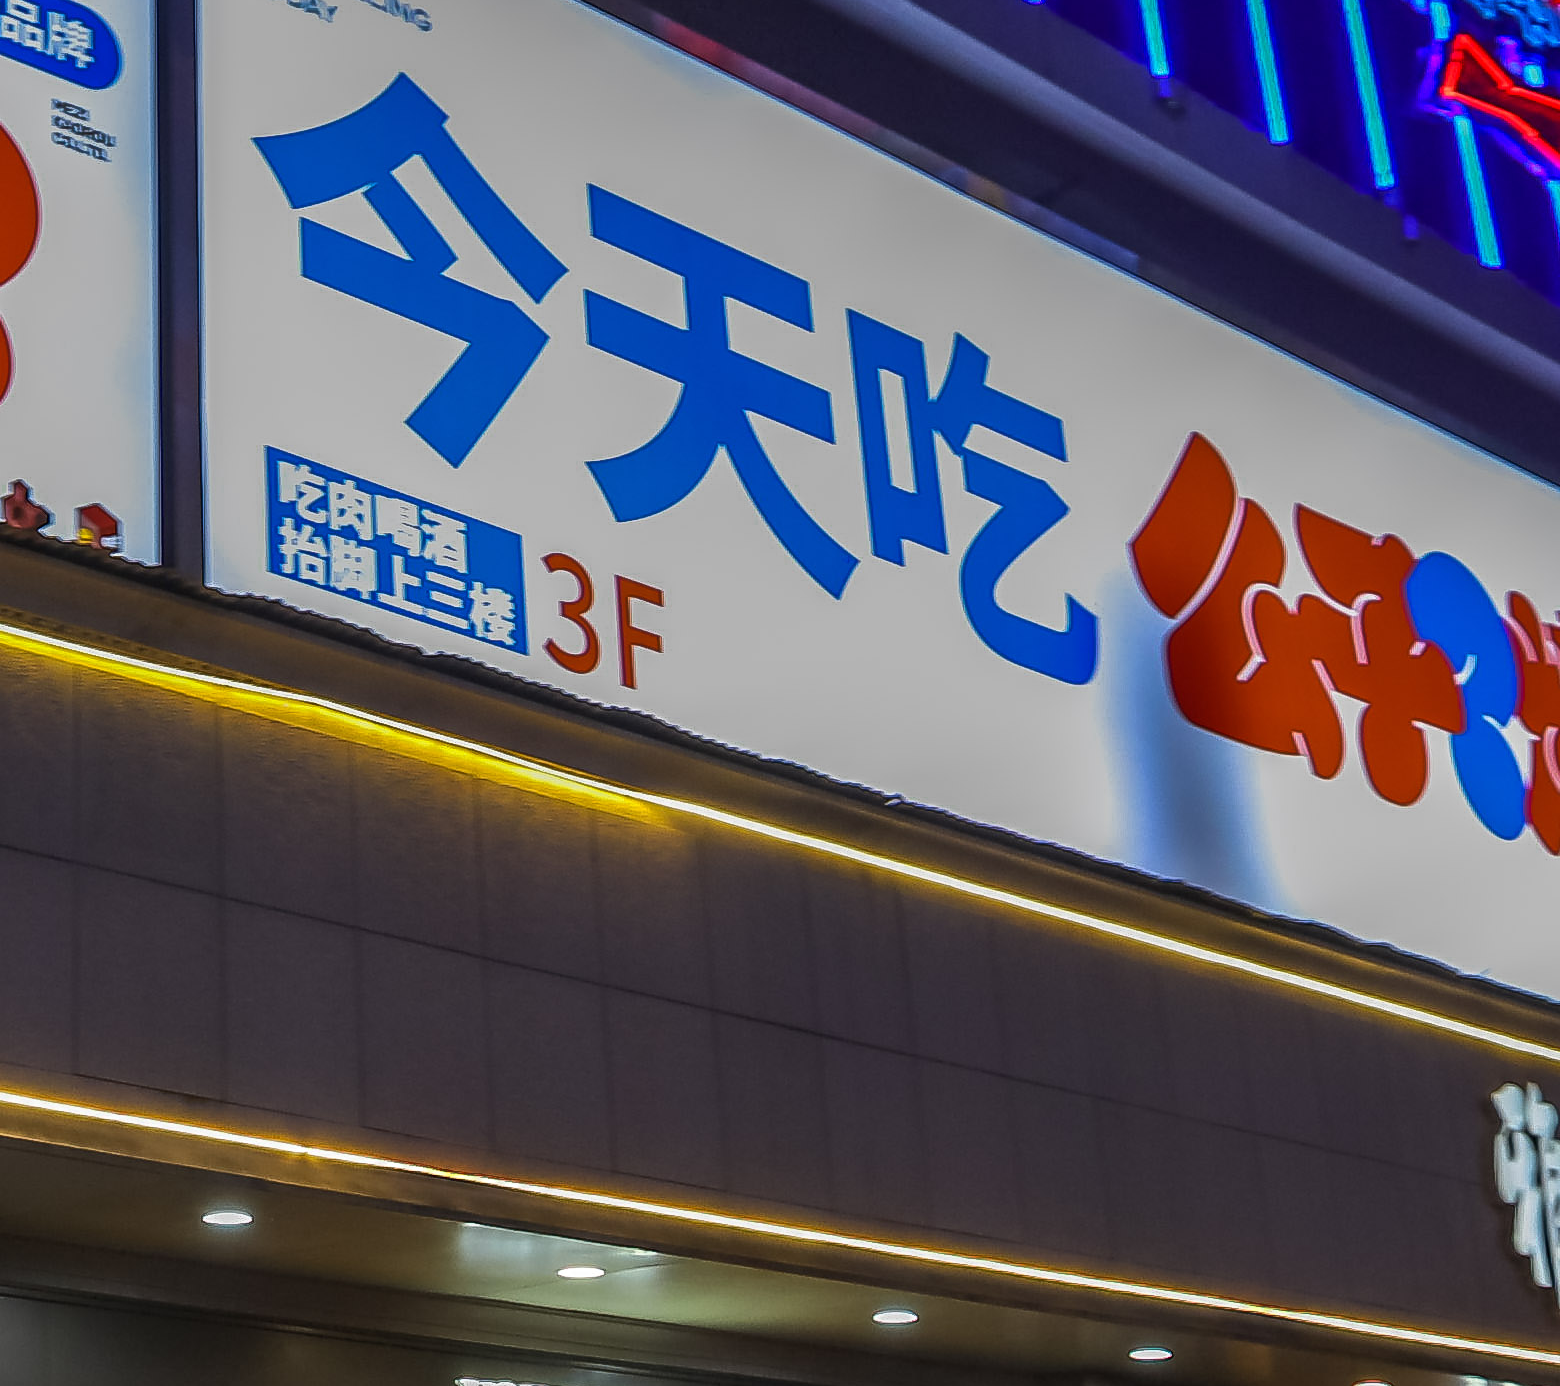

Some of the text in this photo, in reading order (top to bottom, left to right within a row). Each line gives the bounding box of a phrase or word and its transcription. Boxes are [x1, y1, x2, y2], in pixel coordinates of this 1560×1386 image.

[275, 459, 471, 576] 吃肉喝酒
[275, 518, 518, 647] 抬脚上三楼
[541, 551, 665, 690] 3F
